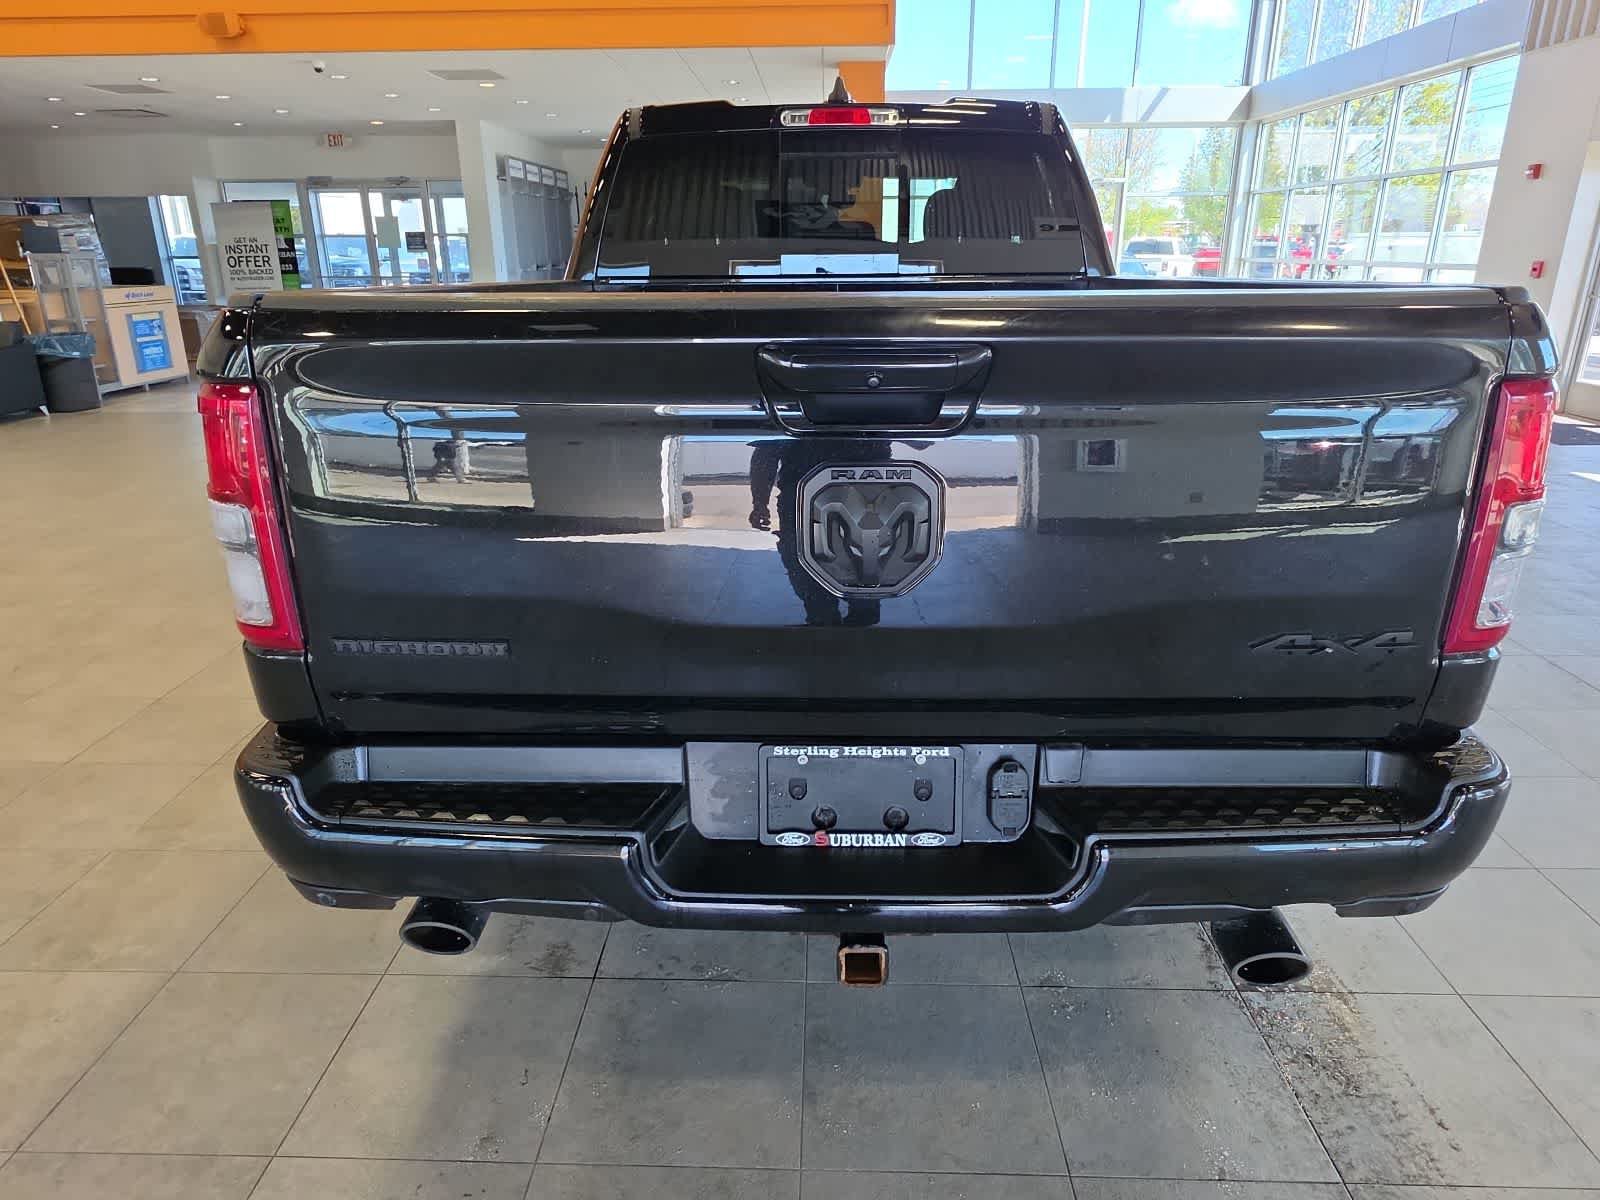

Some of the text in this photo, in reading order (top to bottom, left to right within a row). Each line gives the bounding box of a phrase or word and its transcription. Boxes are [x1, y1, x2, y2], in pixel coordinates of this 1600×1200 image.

[327, 133, 344, 147] EXIT
[224, 244, 271, 255] INSTANT
[226, 255, 272, 268] OFFER
[830, 469, 912, 480] RAM
[773, 746, 950, 758] Sterling Heights Ford
[780, 830, 942, 847] Ford SUBURBAN Ford
